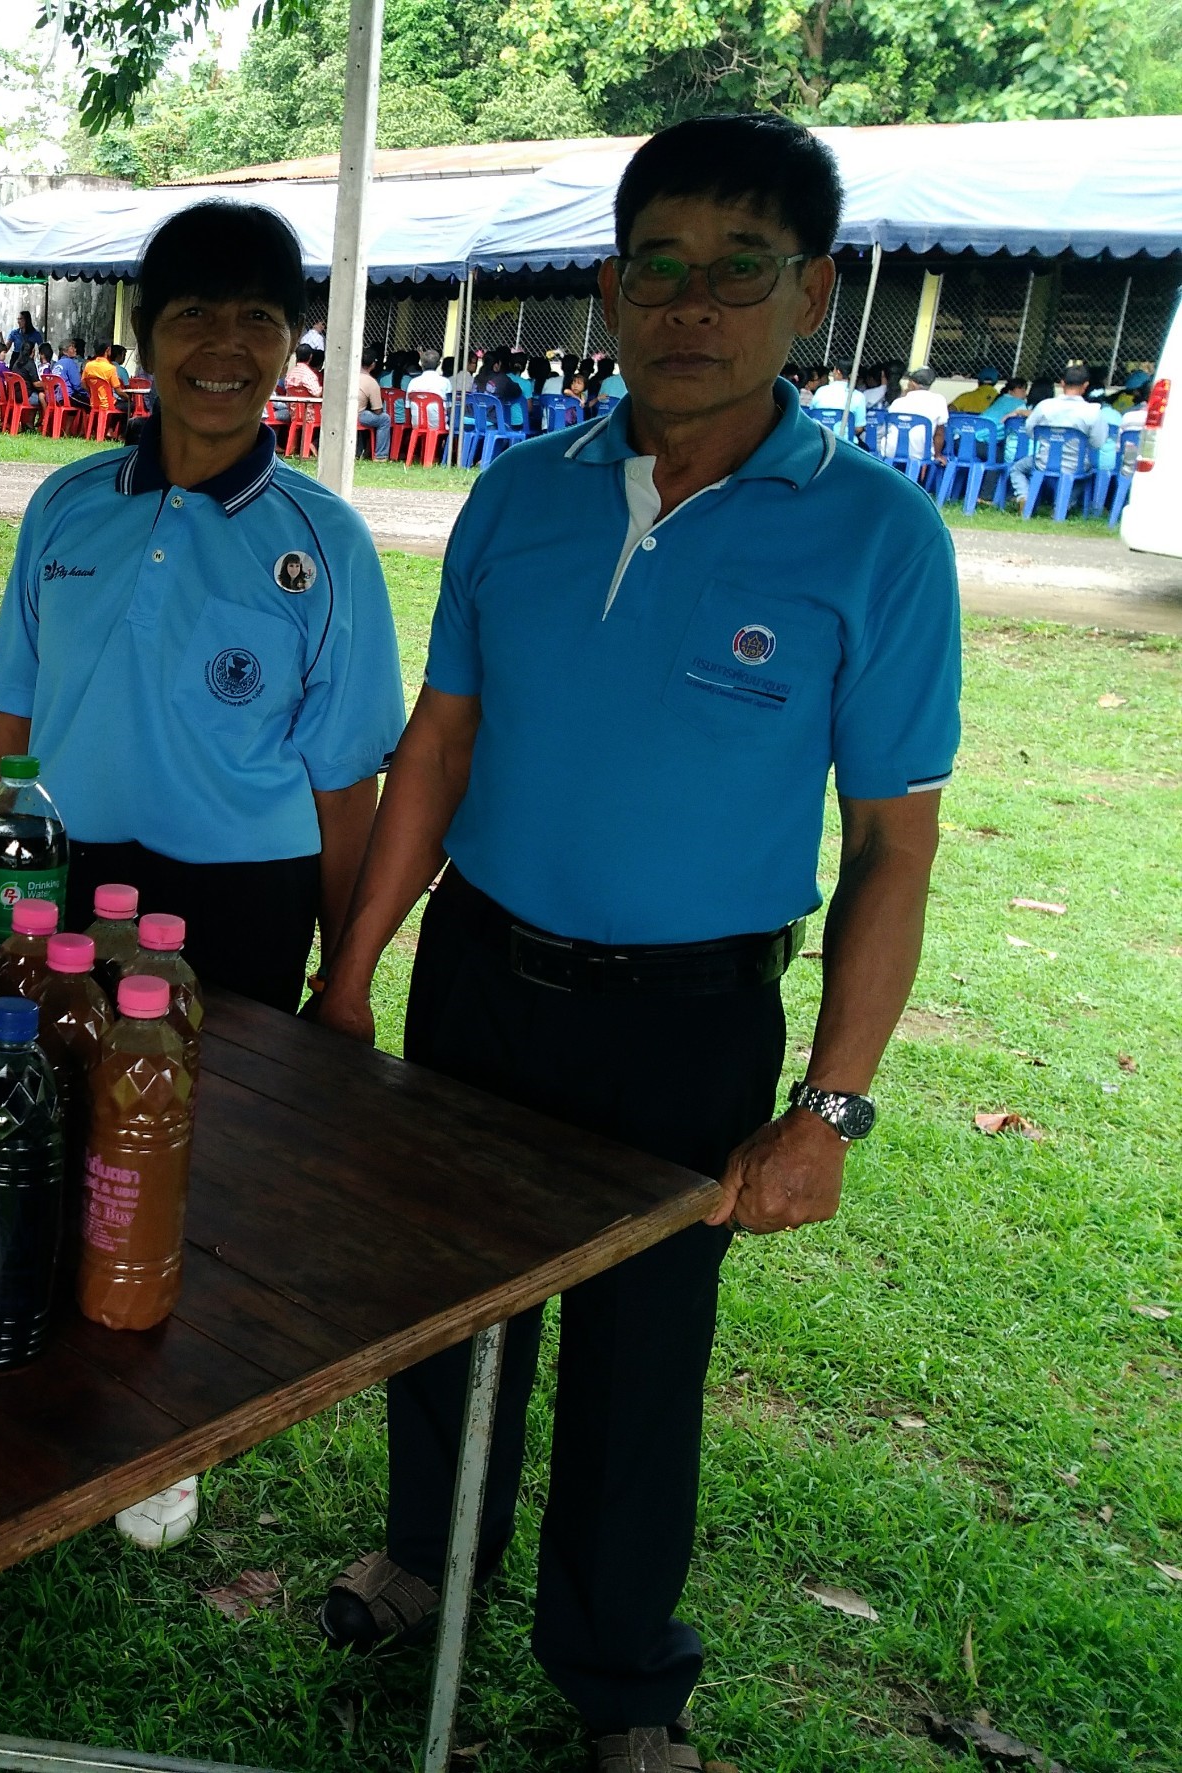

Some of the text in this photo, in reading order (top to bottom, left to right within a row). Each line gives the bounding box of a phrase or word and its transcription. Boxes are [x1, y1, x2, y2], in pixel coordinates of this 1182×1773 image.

[27, 880, 60, 890] Drinking
[4, 888, 18, 904] PT
[27, 890, 50, 898] Water
[104, 1206, 136, 1226] Boy
